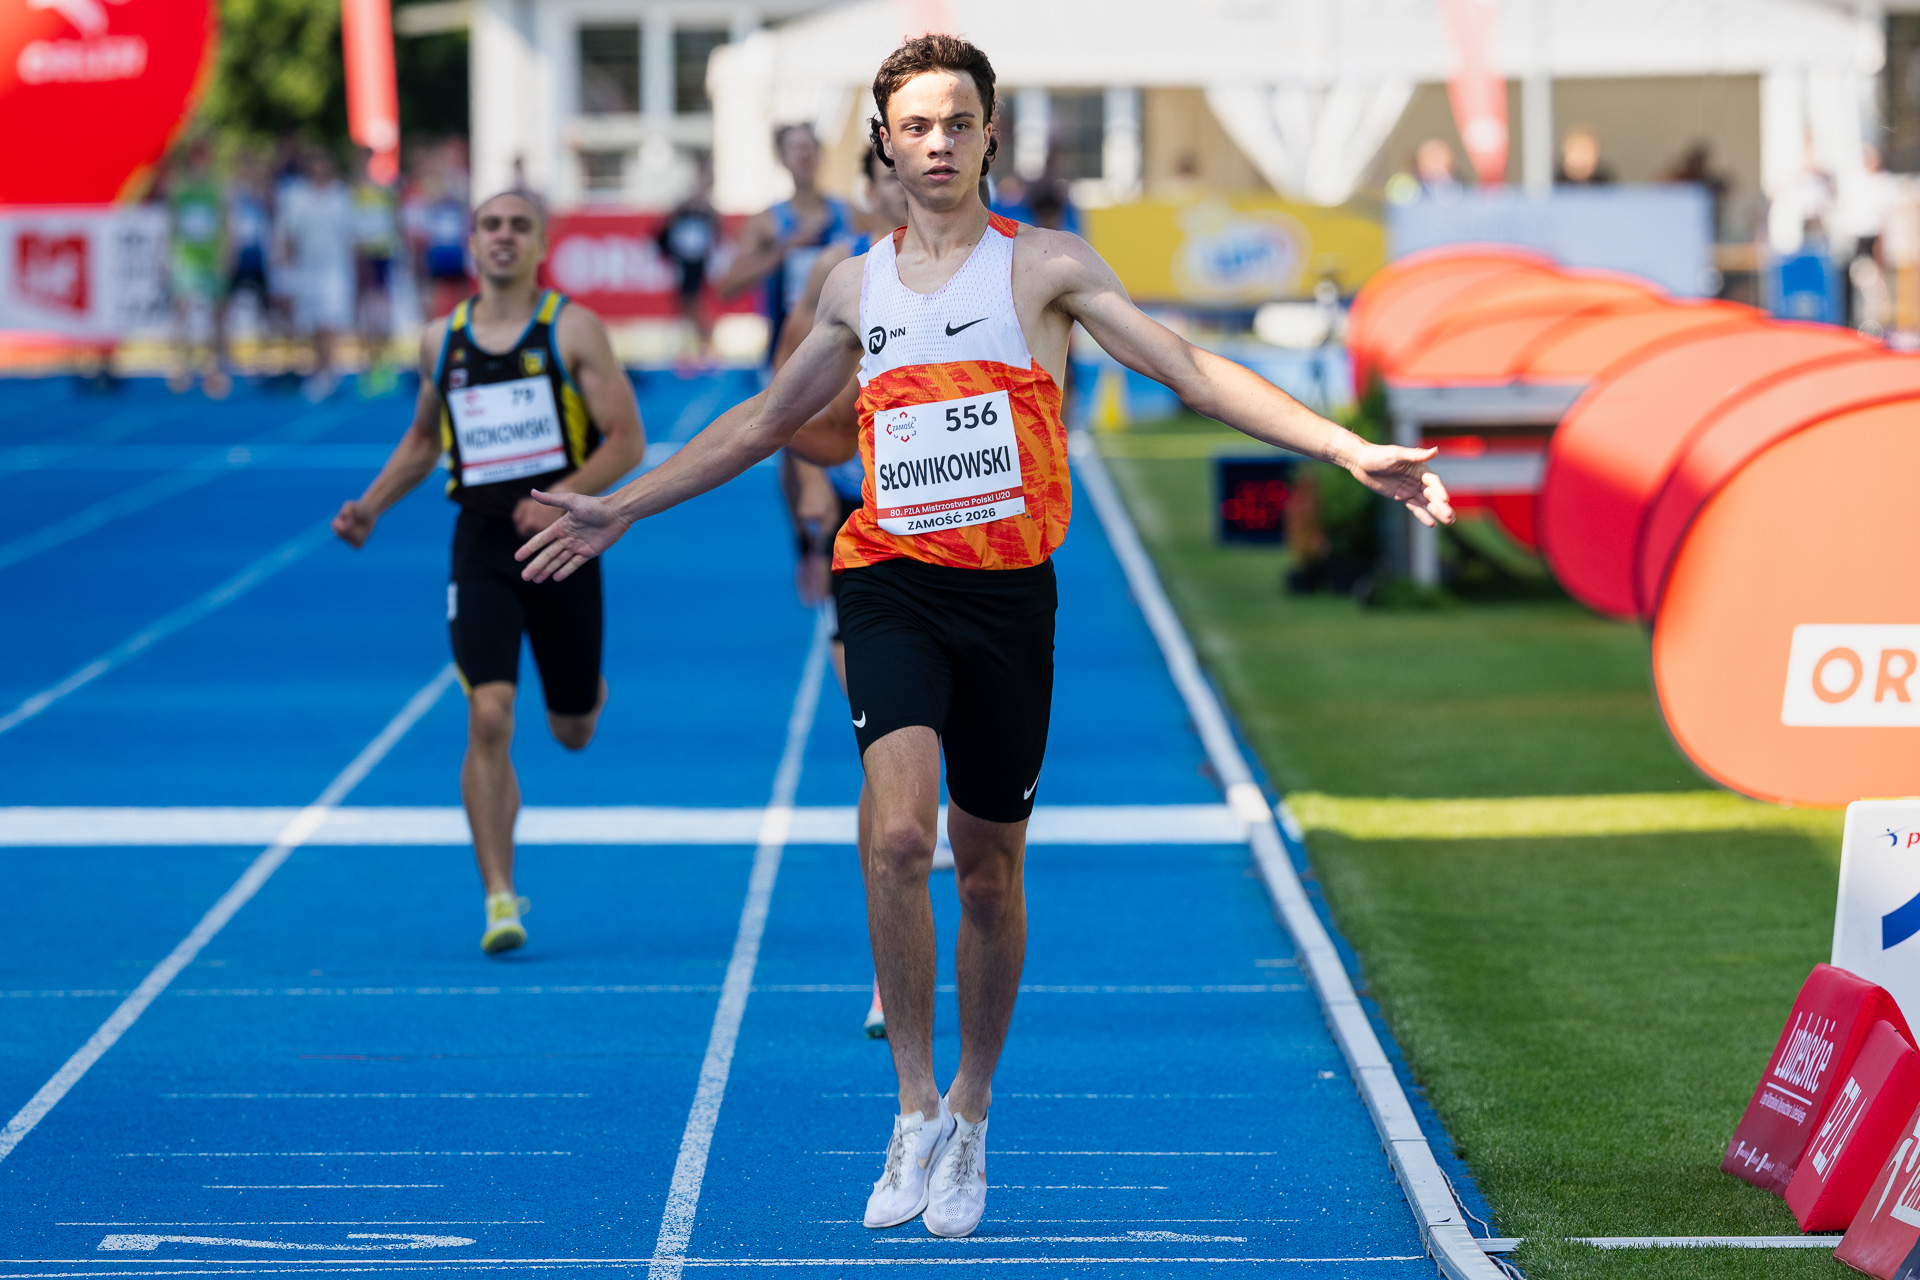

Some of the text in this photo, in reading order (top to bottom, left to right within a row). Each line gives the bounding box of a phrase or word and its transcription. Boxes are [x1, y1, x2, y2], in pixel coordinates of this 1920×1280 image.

[889, 327, 906, 339] NN
[892, 421, 915, 431] ZAMOŚĆ
[945, 401, 998, 432] 556
[879, 445, 1012, 491] SŁOWIKOWSKI
[890, 490, 1011, 517] 80. PZLA Mistrzostwa Polski U20
[907, 507, 996, 531] ZAMOŚĆ 2026
[1811, 646, 1920, 704] OR
[1773, 1011, 1836, 1094] Lubelskie
[1808, 1075, 1868, 1183] PZLA
